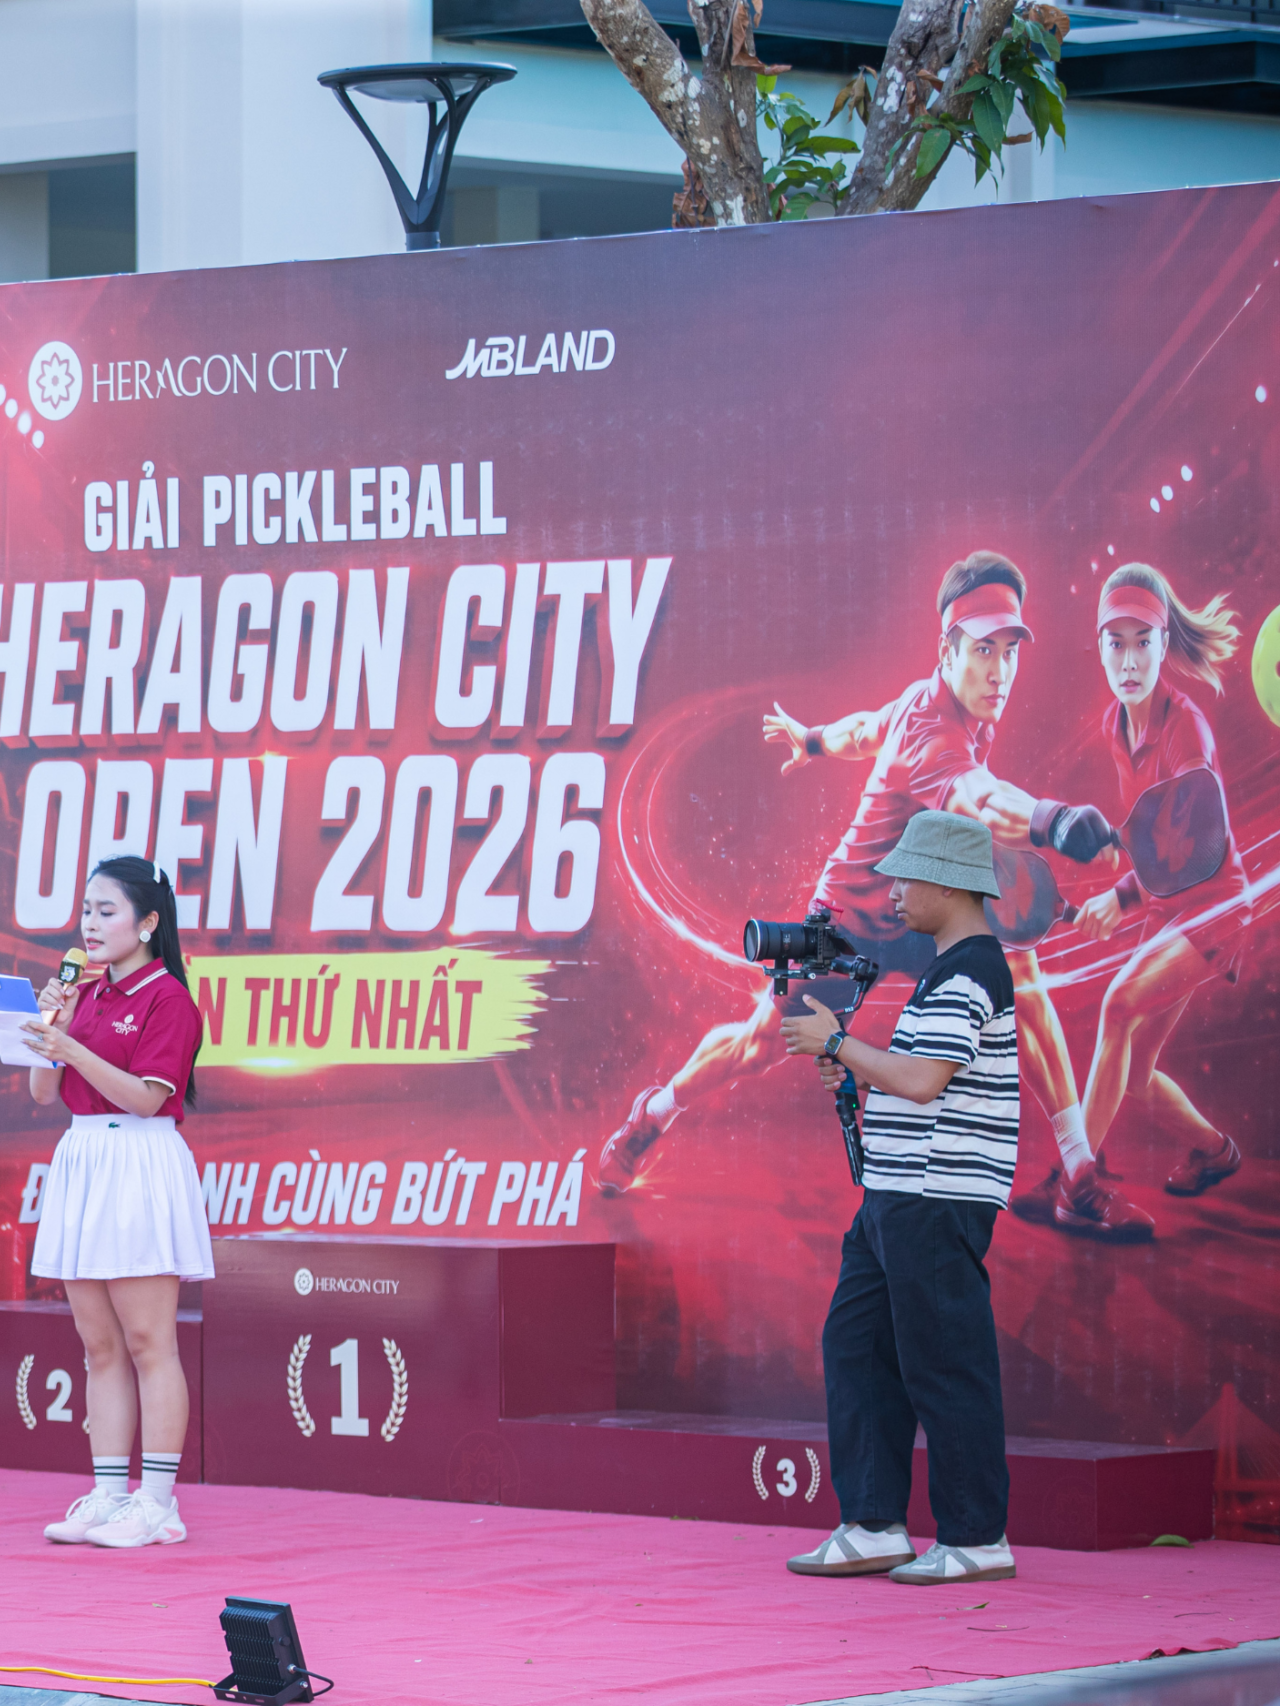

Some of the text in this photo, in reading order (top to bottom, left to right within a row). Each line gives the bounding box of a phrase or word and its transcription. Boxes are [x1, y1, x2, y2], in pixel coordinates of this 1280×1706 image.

[92, 347, 347, 402] HERAGON CITY
[445, 329, 616, 380] MBLAND
[84, 461, 507, 552] GIẢI PICKLEBALL
[434, 556, 673, 728] CITY
[311, 752, 606, 933] 2026
[244, 964, 341, 1049] THỨ
[351, 958, 483, 1051] NHẤT
[201, 1148, 587, 1227] NH CÙNG BỨT PHÁ
[316, 1277, 400, 1295] HERAGON CITY
[46, 1368, 73, 1422] 2
[330, 1338, 370, 1437] 1
[775, 1458, 798, 1498] 3
